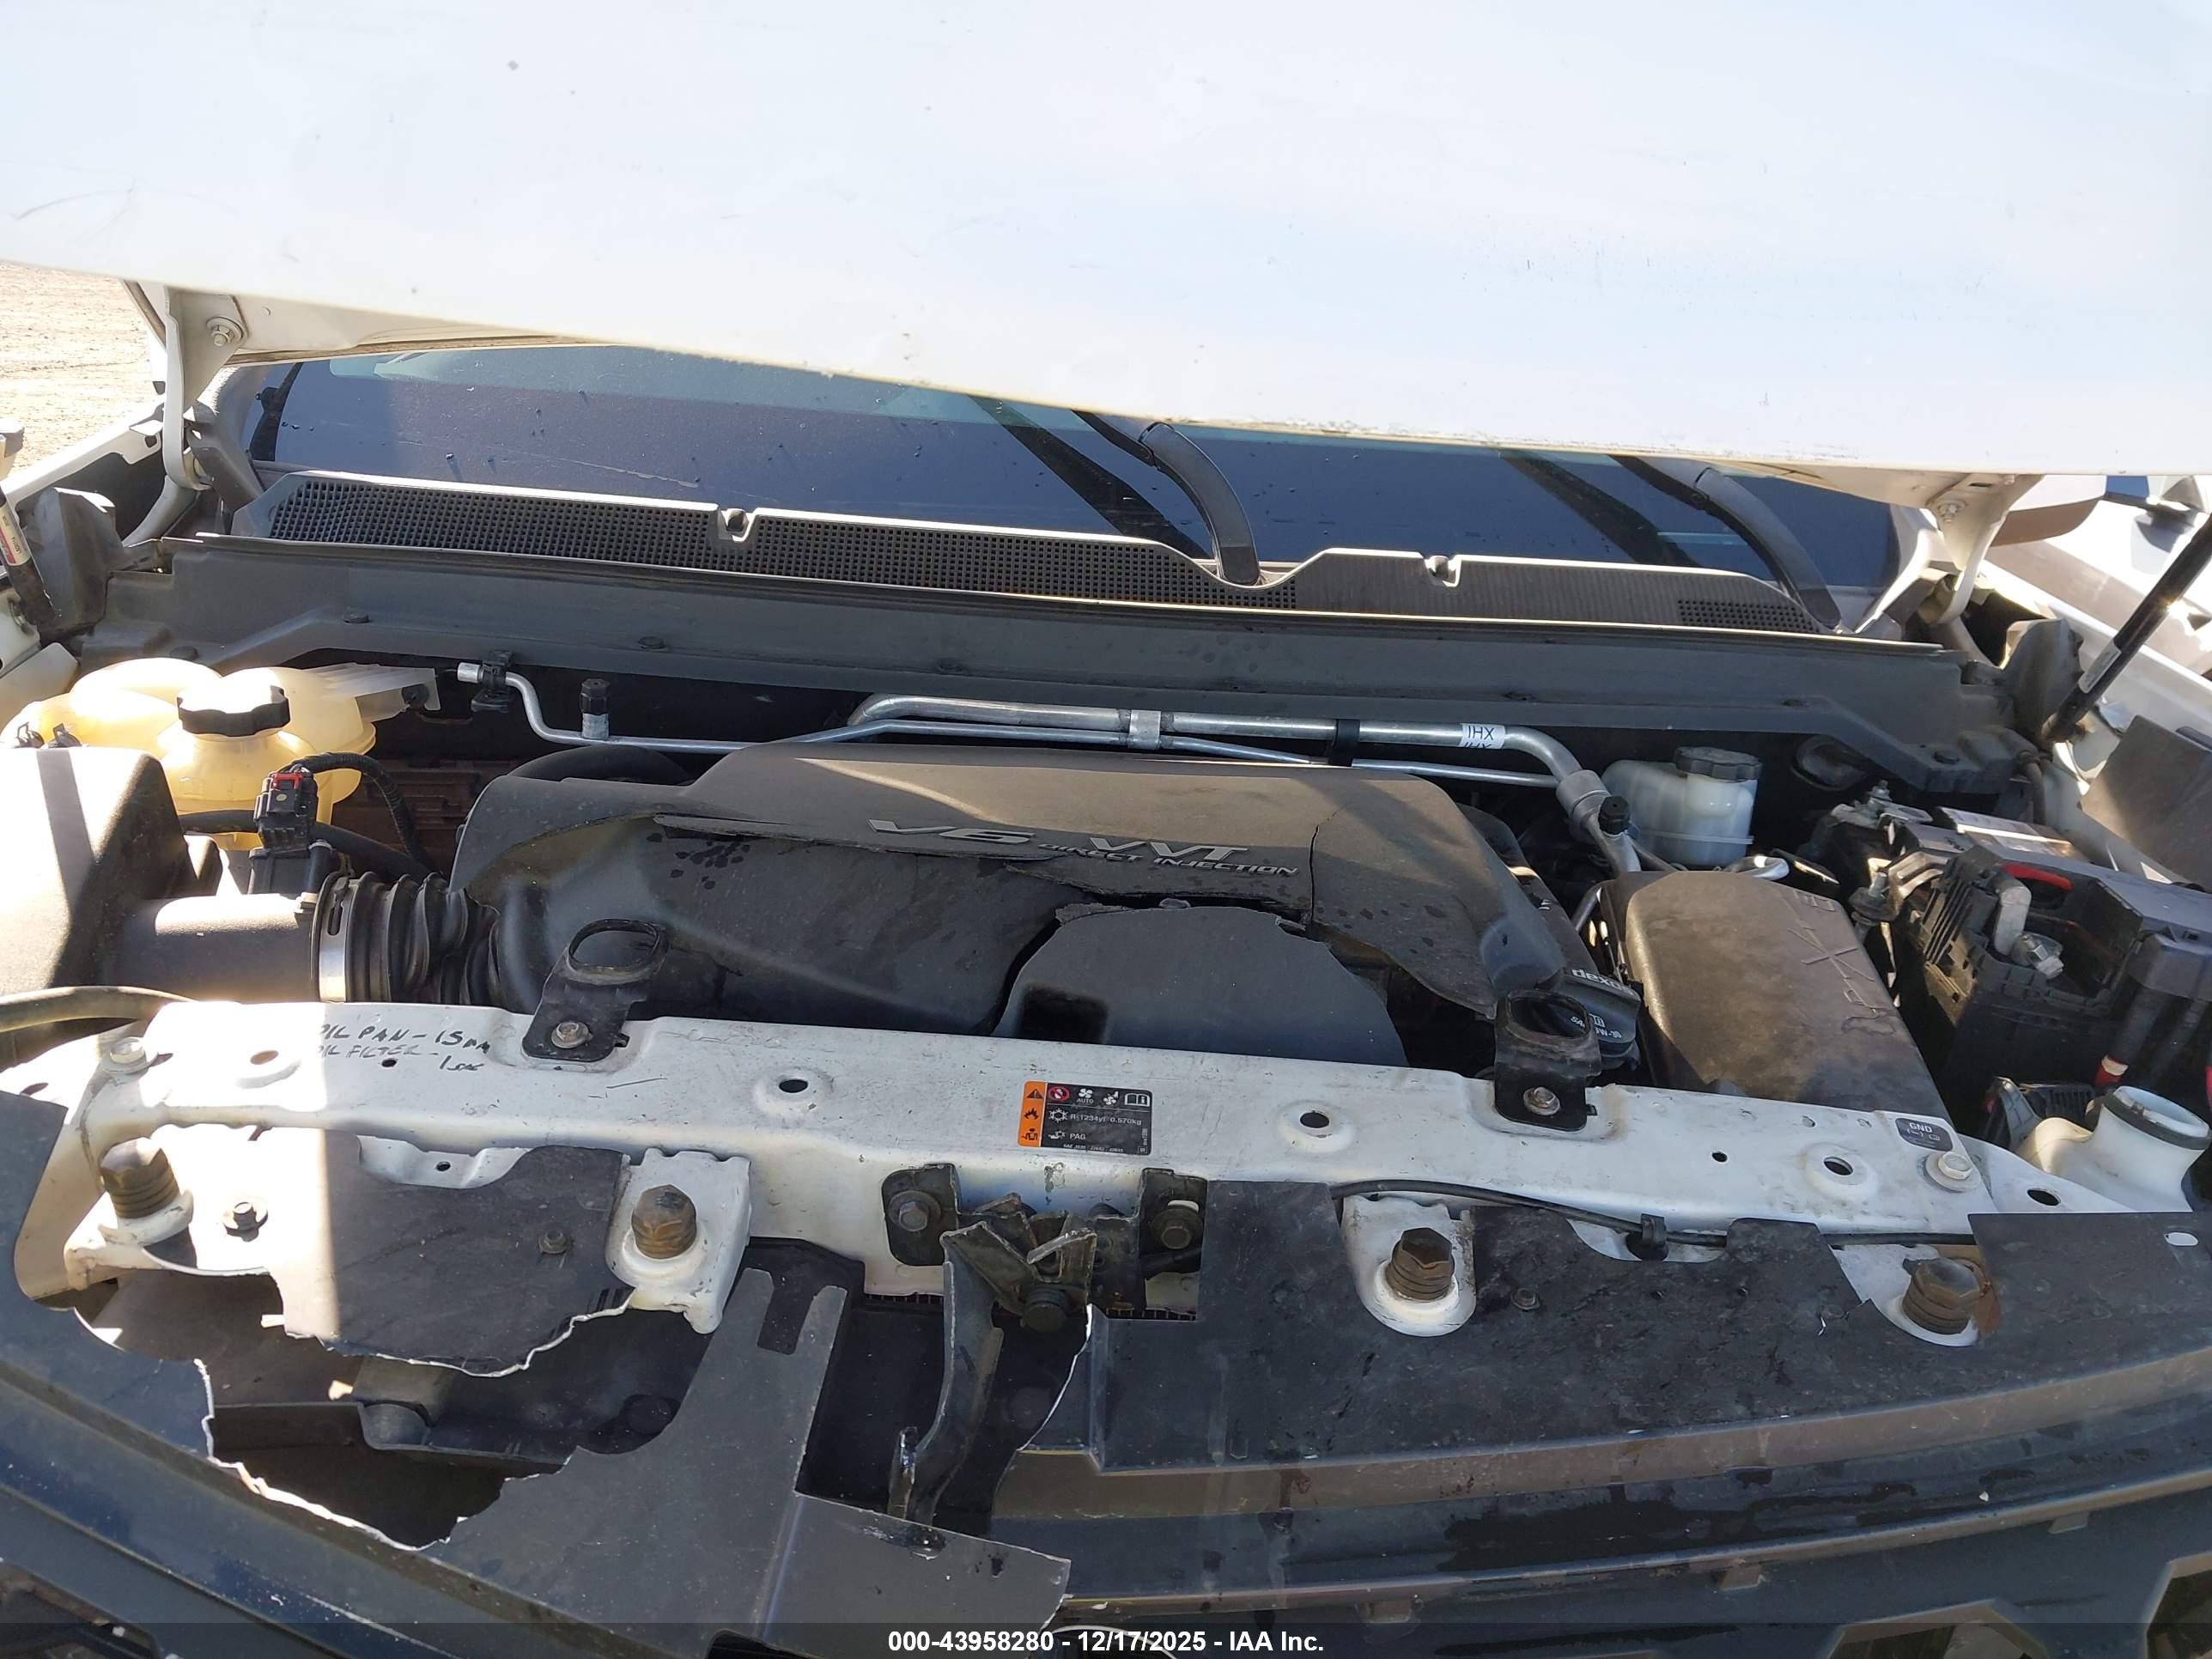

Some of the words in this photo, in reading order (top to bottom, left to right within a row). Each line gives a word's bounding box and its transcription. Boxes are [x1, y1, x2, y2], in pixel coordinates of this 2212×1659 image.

[866, 818, 1036, 845] V6
[1089, 836, 1249, 862] VVT
[1037, 842, 1145, 864] DIRECT
[1153, 857, 1298, 877] INJECTION
[1570, 1016, 1586, 1028] SA
[1109, 1116, 1143, 1126] 0.570kg
[1909, 1122, 1933, 1133] GND
[1070, 1133, 1086, 1141] PAG
